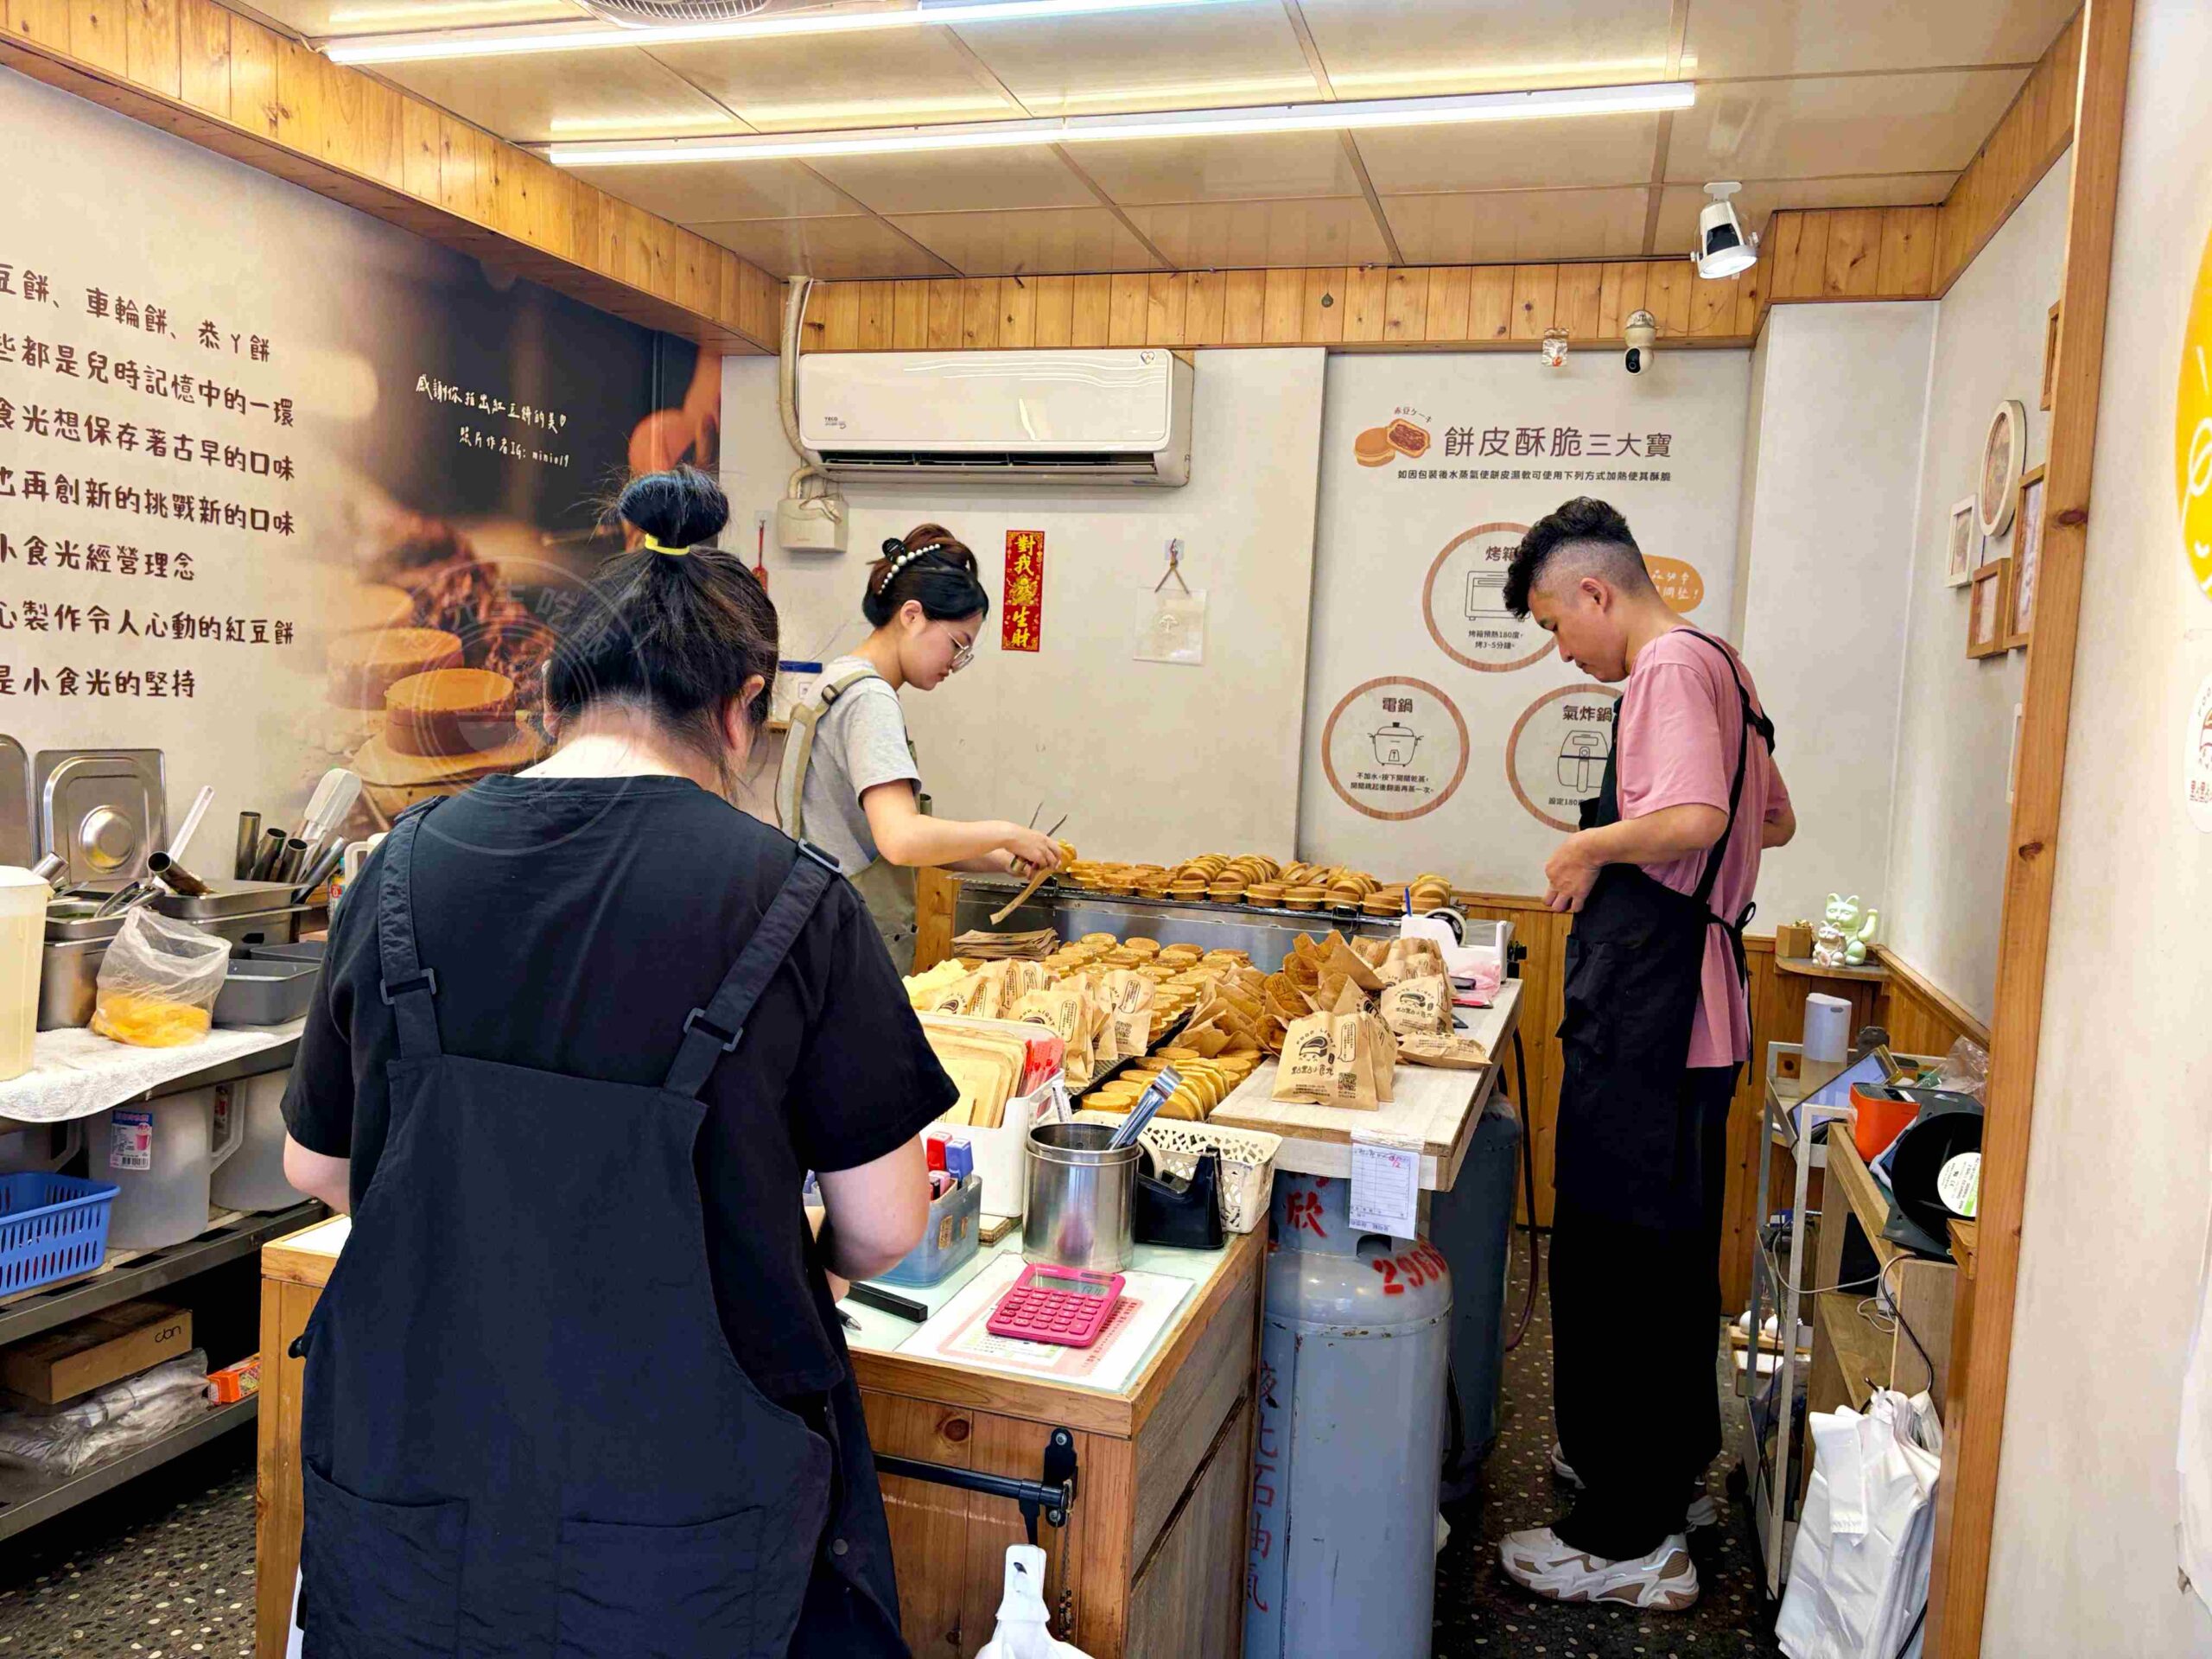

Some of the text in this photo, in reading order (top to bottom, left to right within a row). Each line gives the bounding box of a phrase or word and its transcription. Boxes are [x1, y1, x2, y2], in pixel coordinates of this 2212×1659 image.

[1444, 425, 1673, 459] 餅皮酥脆三大寶
[1382, 697, 1413, 713] 電鍋
[1562, 705, 1612, 722] 氣炸鍋
